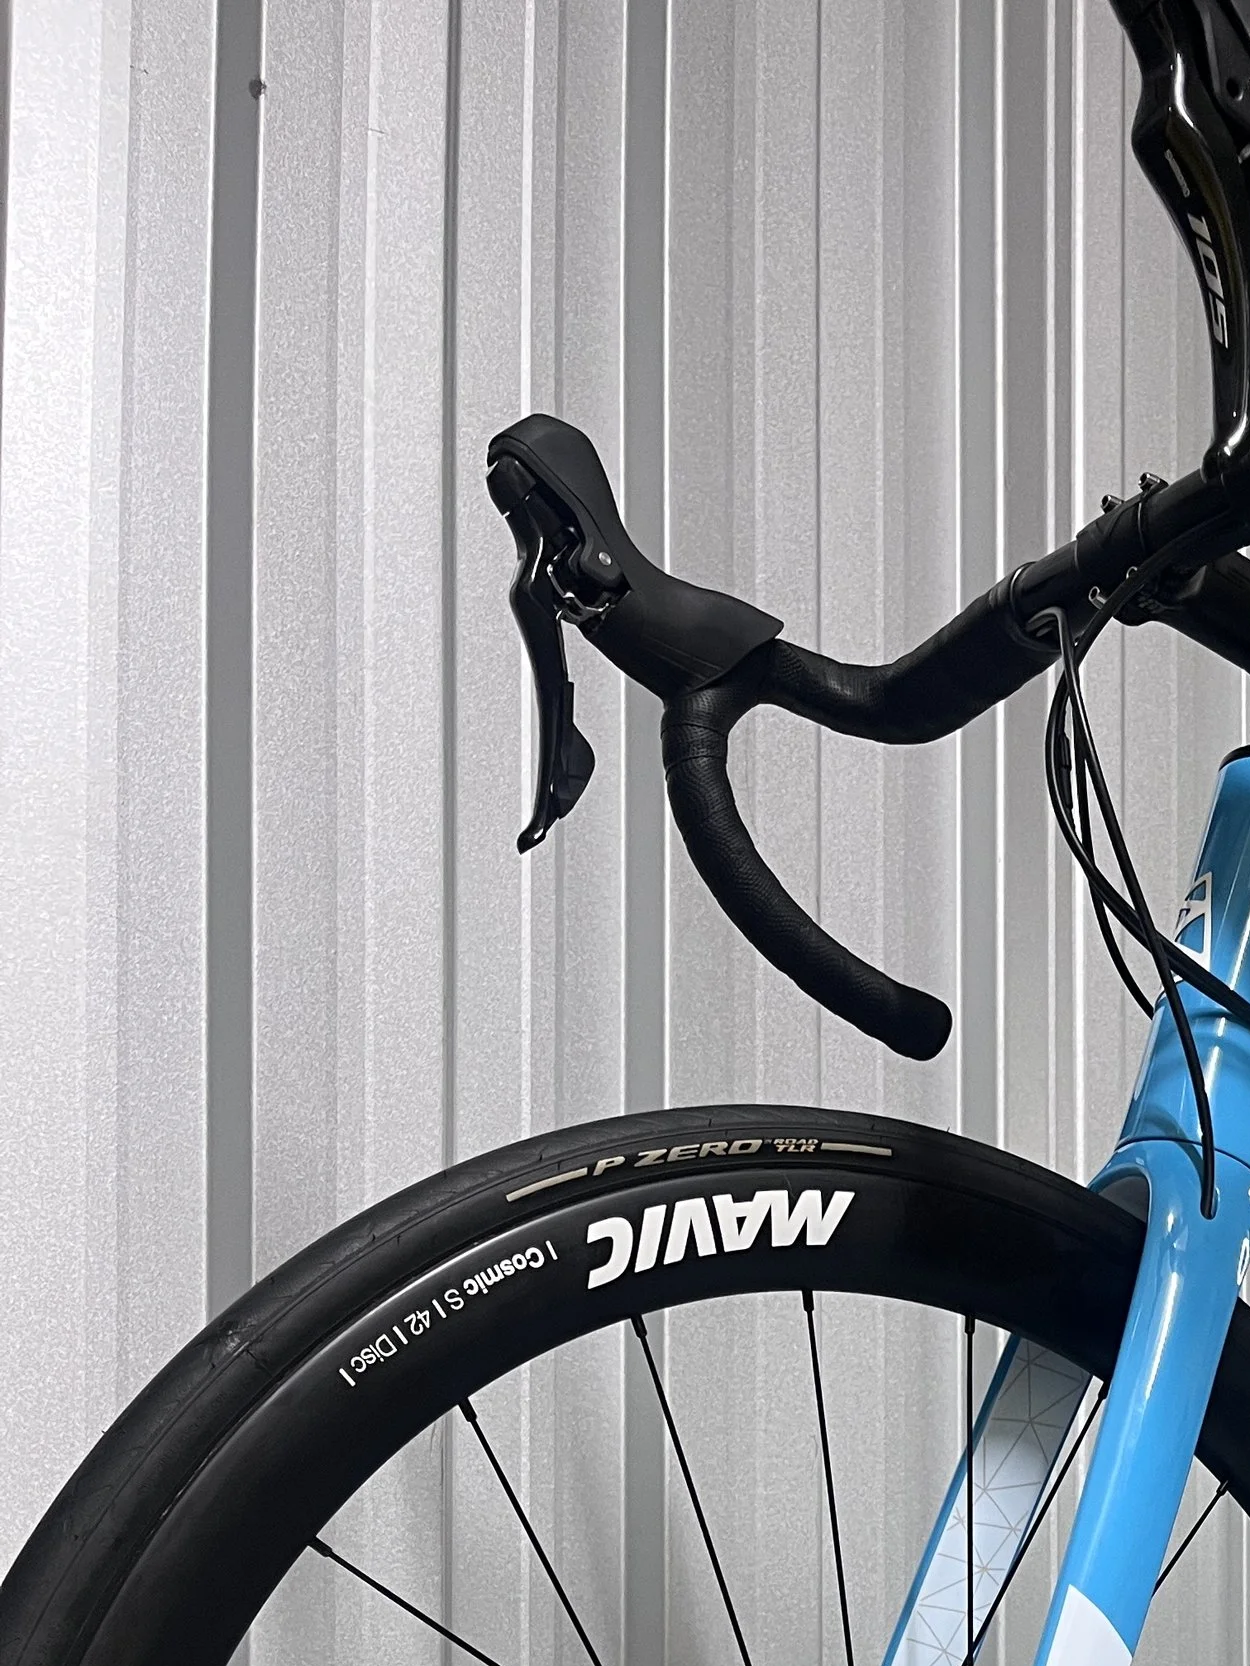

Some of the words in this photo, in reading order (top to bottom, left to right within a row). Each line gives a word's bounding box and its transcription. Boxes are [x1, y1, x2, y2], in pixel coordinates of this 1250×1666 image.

[1187, 213, 1228, 349] 105
[592, 1156, 625, 1176] P
[634, 1139, 763, 1168] ZERO
[776, 1144, 816, 1152] TLR
[587, 1190, 856, 1289] MAVIC
[463, 1247, 545, 1295] Cosmic
[444, 1288, 465, 1311] S
[403, 1310, 431, 1336] 42
[350, 1333, 398, 1373] Disc
